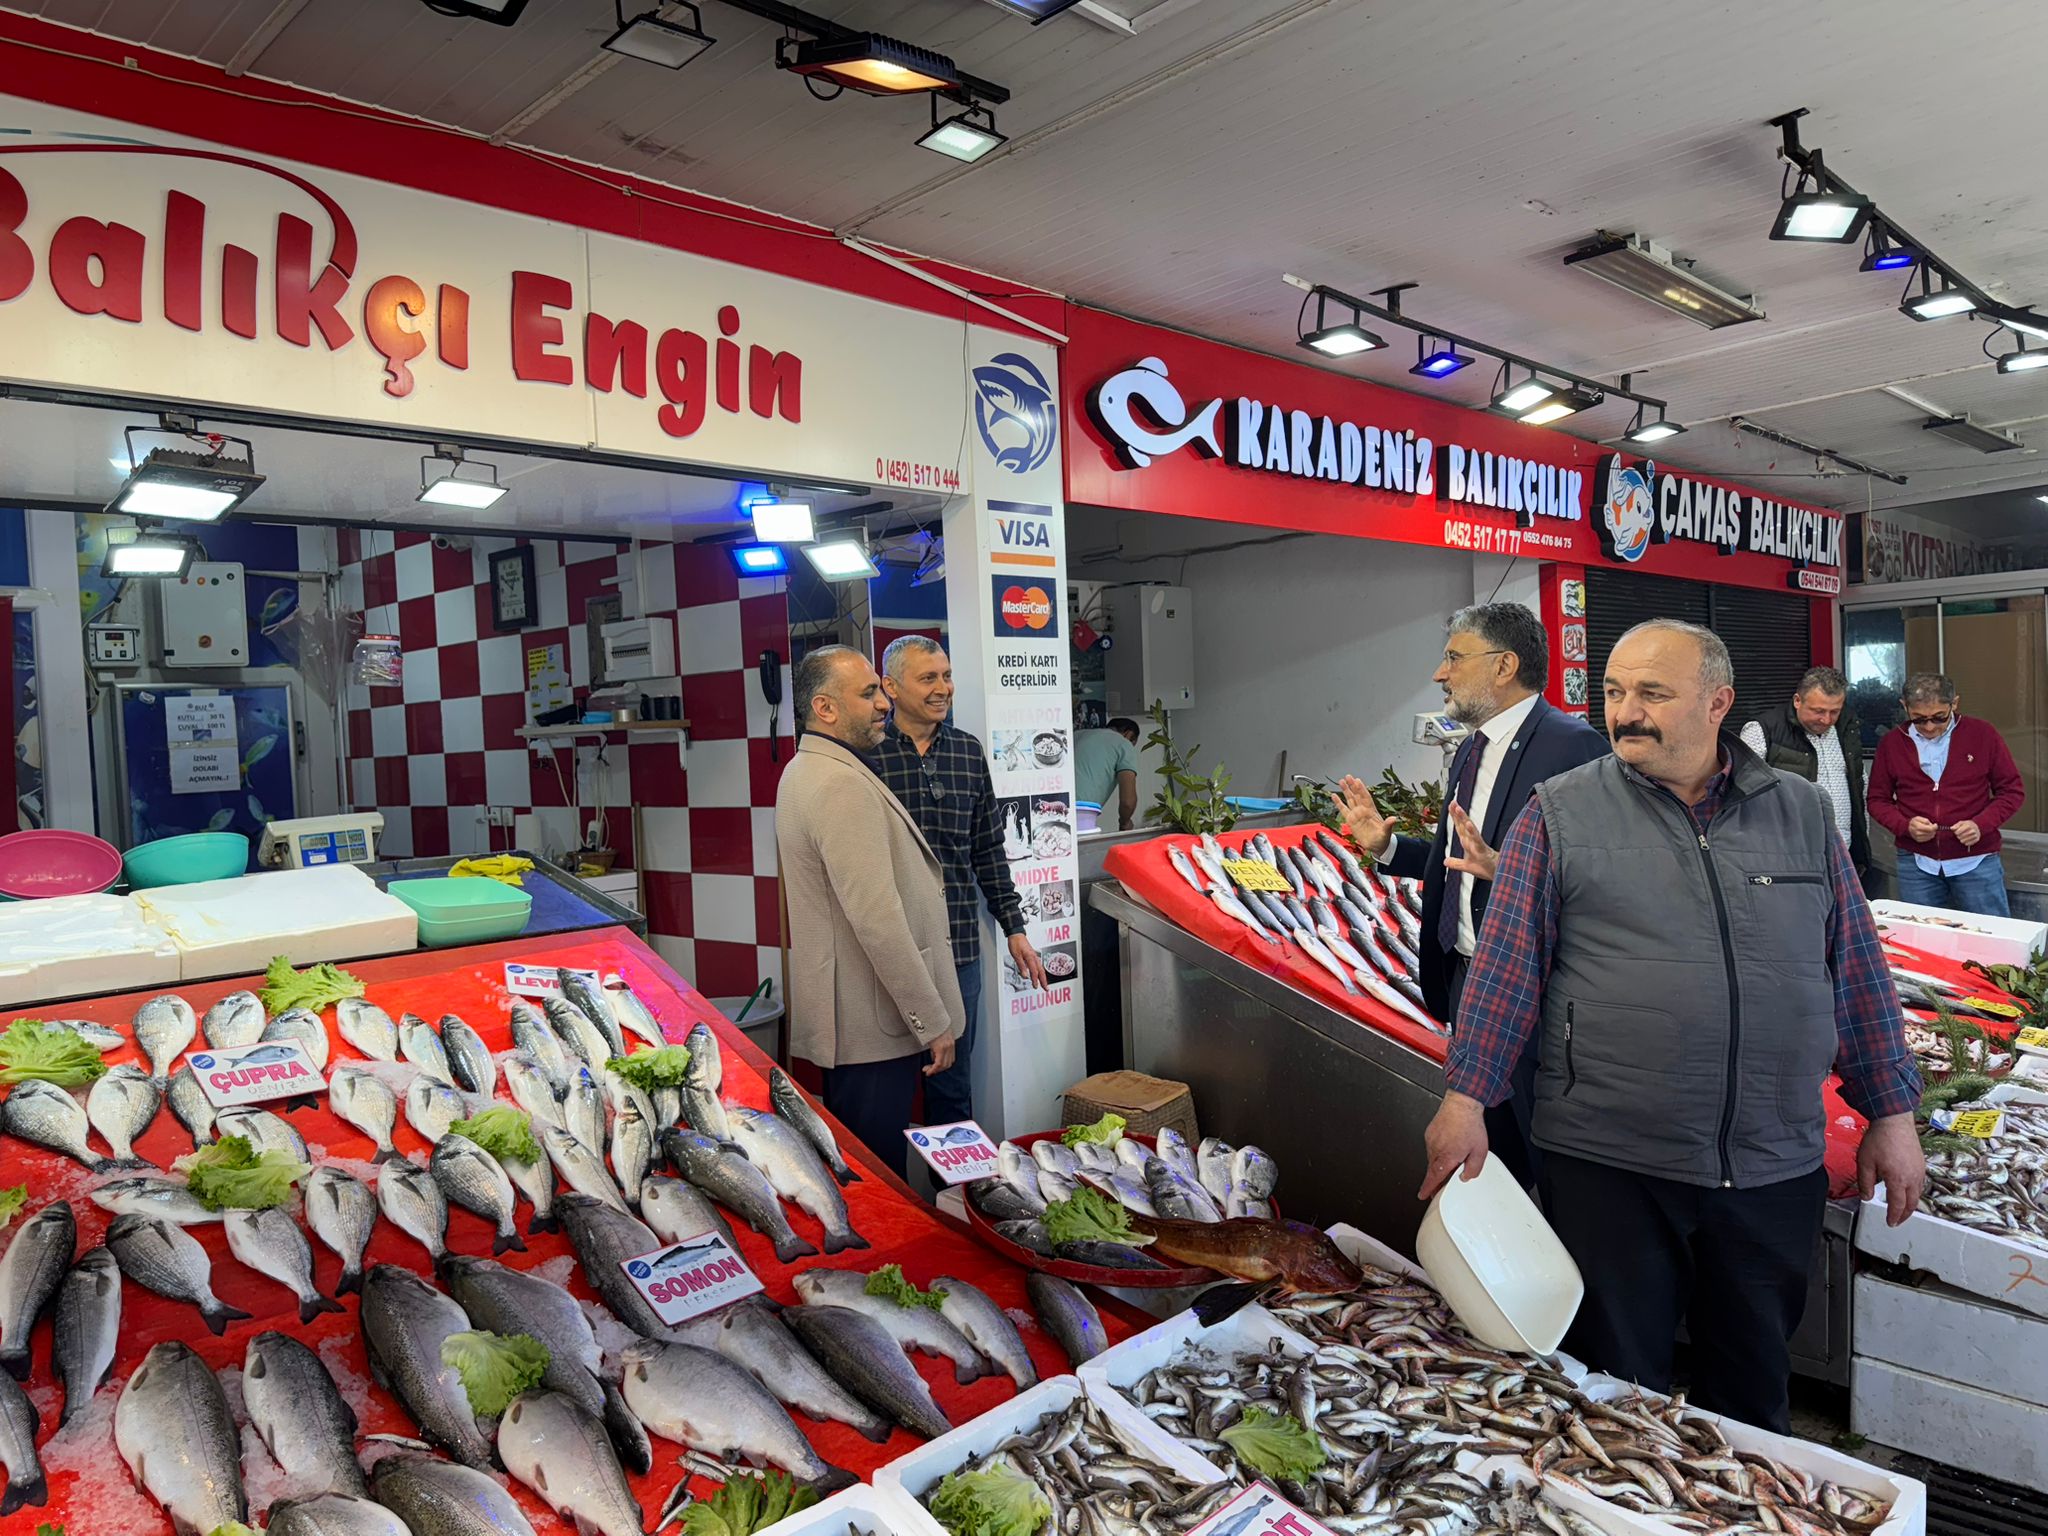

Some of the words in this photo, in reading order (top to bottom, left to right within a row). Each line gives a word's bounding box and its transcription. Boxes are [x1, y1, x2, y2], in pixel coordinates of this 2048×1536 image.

[511, 270, 803, 439] Engin
[876, 457, 883, 479] 0
[886, 458, 911, 489] (452)
[914, 463, 931, 486] 517
[934, 466, 941, 487] 0
[943, 468, 960, 490] 444
[1238, 397, 1433, 496] KARADENİZ
[1449, 444, 1582, 528] BALIKÇILIK
[996, 518, 1051, 548] VISA
[1444, 519, 1471, 548] 0452
[1473, 524, 1493, 550] 517
[1494, 528, 1508, 552] 17
[1509, 530, 1522, 554] 77
[1523, 531, 1540, 545] 0552
[1563, 537, 1572, 549] 75
[1750, 496, 1844, 569] BALIKÇILIK
[1002, 600, 1050, 616] MasterCard
[997, 651, 1028, 668] KREDİ
[1030, 655, 1058, 668] KARTI
[1000, 671, 1057, 691] GEÇERLİDİR
[1014, 865, 1060, 887] MİDYE
[1011, 986, 1072, 1016] BULUNUR
[209, 1060, 311, 1094] ÇUPRA
[930, 1143, 998, 1171] ÇUPRA
[648, 1255, 746, 1304] SOMON
